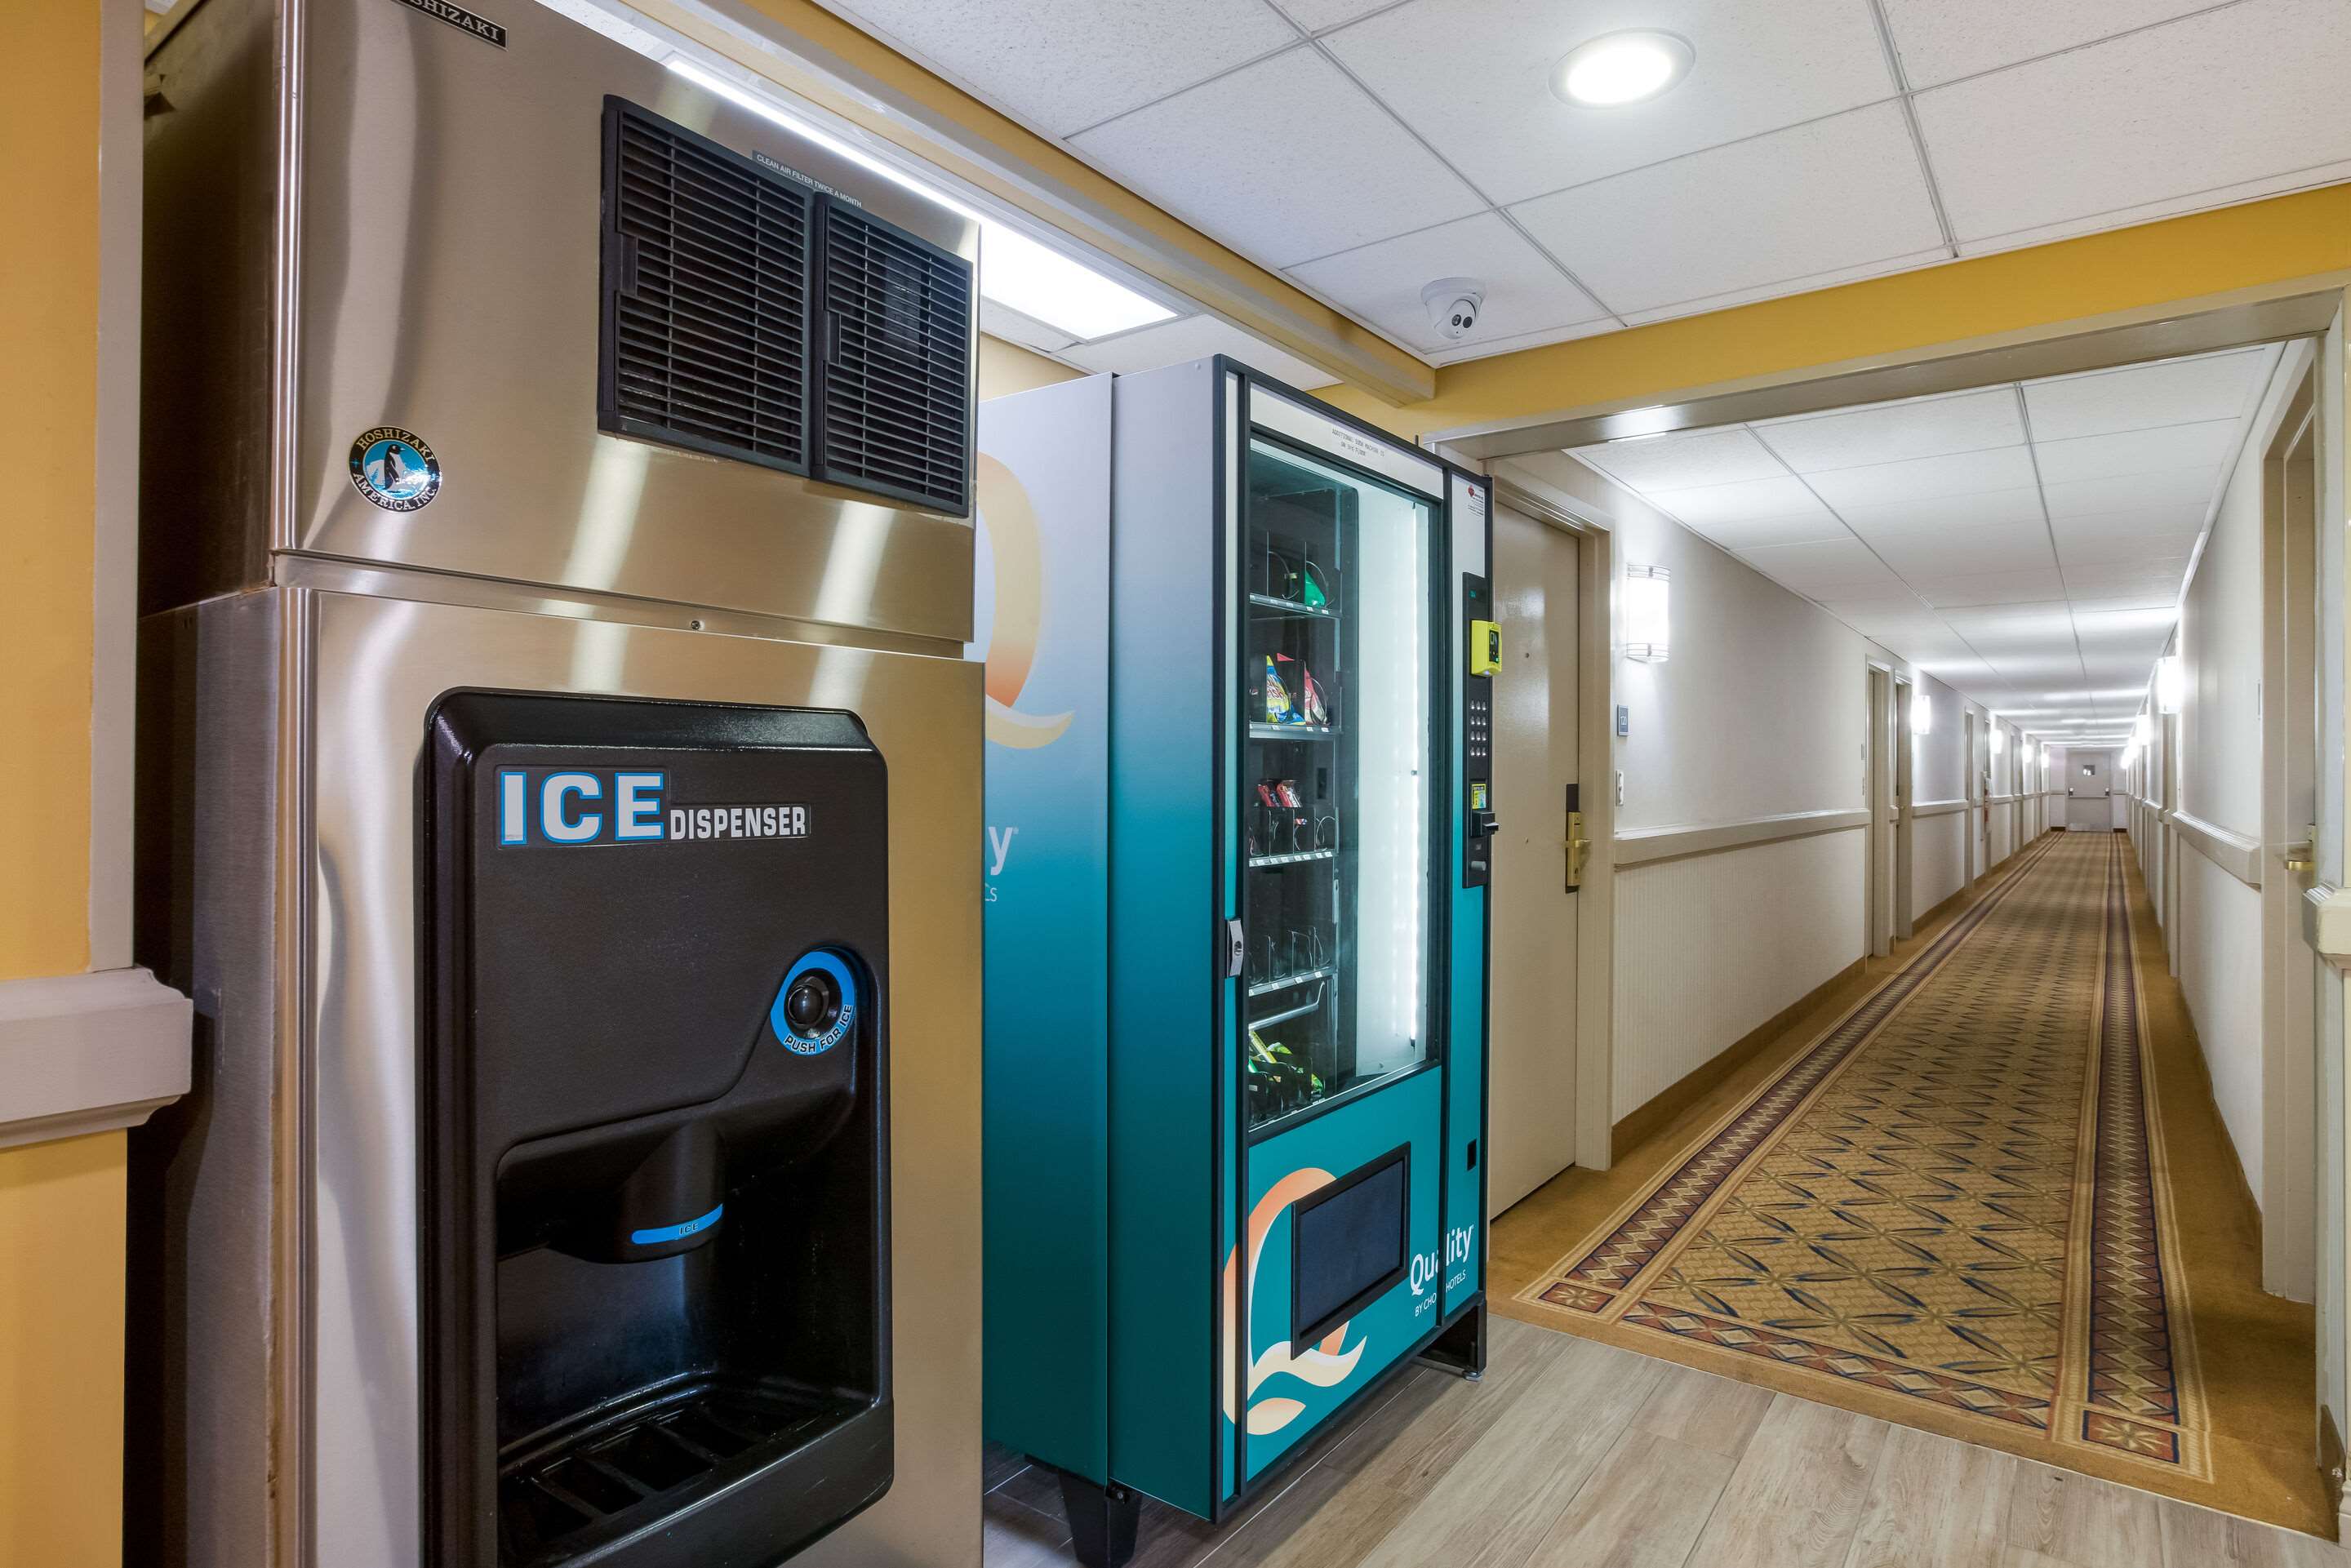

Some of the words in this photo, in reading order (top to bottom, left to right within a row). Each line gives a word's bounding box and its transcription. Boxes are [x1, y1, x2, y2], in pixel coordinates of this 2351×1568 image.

[410, 0, 499, 41] SHIZAKI
[757, 154, 779, 171] CLEAN
[780, 165, 791, 175] AIR
[792, 171, 813, 185] FILTER
[814, 180, 834, 195] TWICE
[840, 193, 862, 207] MONTH
[356, 429, 435, 462] HOSHIZAKI
[500, 771, 665, 846] ICE
[669, 806, 807, 841] DISPENSER
[784, 1034, 816, 1054] PUSH
[820, 1028, 842, 1050] FOR
[840, 1005, 853, 1028] ICE
[678, 1223, 699, 1236] ICE
[1415, 1302, 1423, 1317] BY
[1446, 1269, 1466, 1293] HOTELS
